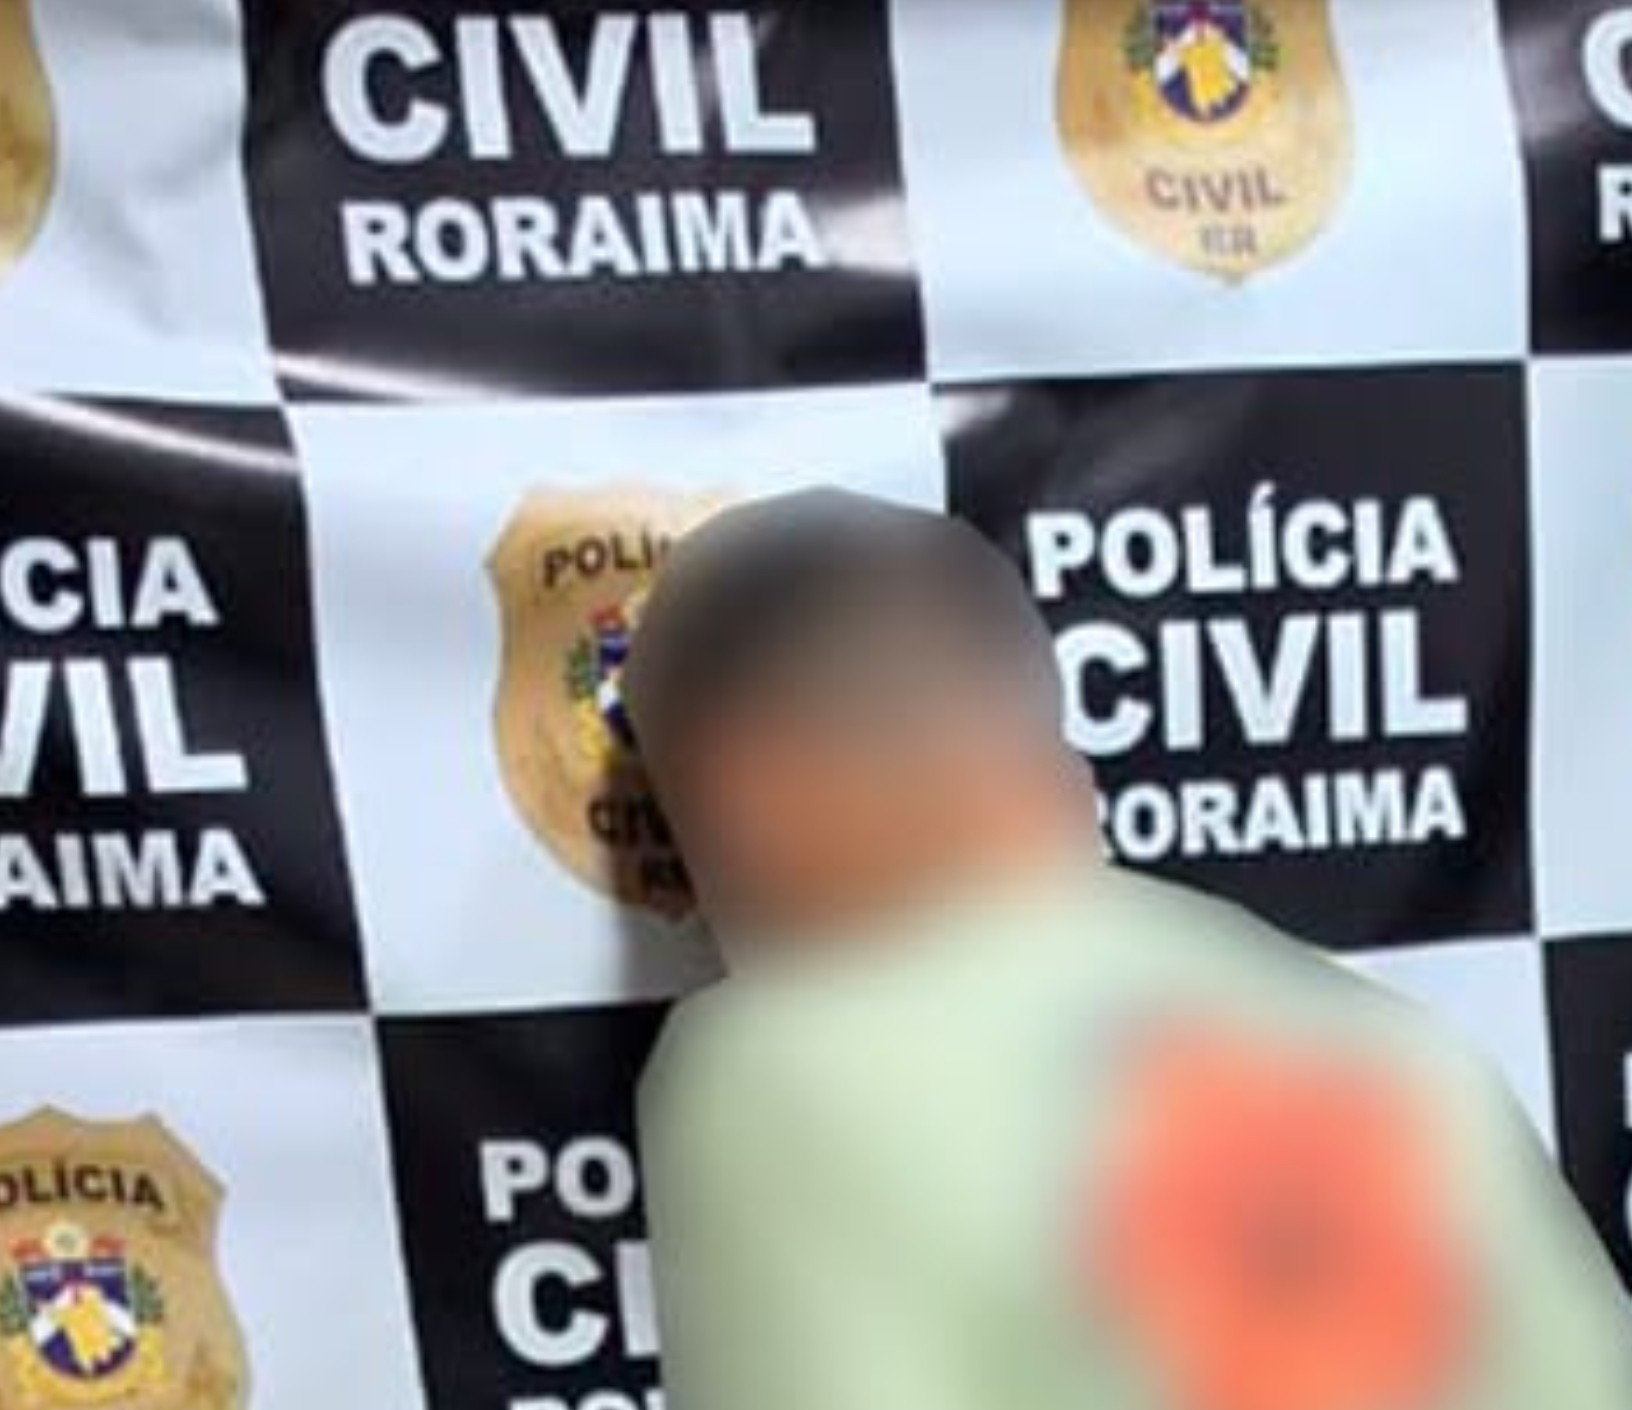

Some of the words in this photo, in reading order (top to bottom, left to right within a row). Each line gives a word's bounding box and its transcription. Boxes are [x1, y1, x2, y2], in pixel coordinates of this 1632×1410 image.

[322, 13, 816, 163] CIVIL
[340, 190, 826, 285] RORAIMA
[1145, 165, 1287, 214] CIVIL
[0, 534, 220, 634] CIA
[1026, 482, 1458, 598] POLÍCIA
[1053, 610, 1468, 757] CIVIL
[1096, 767, 1466, 860] ORAIMA
